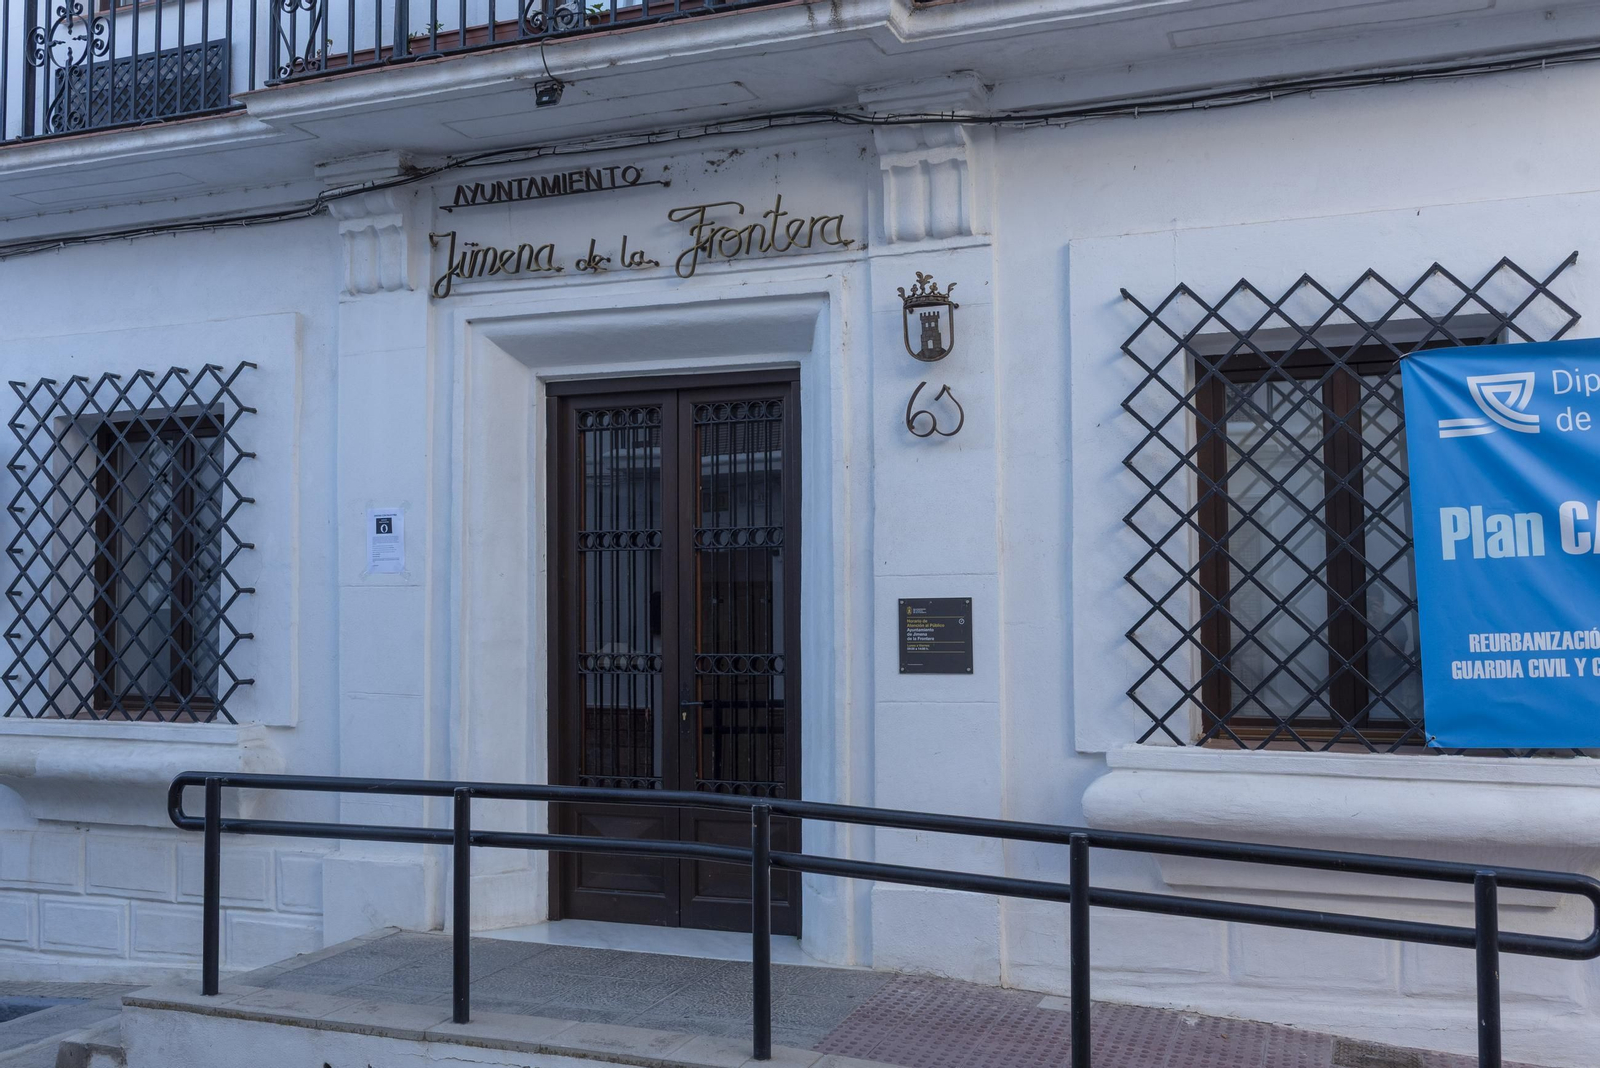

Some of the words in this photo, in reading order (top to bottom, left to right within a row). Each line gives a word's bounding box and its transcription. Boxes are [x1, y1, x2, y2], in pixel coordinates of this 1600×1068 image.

[453, 165, 641, 204] AYUNTAMIENTO
[428, 230, 564, 299] Jimena
[575, 238, 611, 273] de
[620, 234, 660, 268] la
[667, 194, 856, 279] Frontera
[1552, 368, 1600, 397] Dip
[1556, 406, 1592, 432] de
[1439, 505, 1545, 561] Plan
[1559, 500, 1600, 555] C
[1468, 627, 1600, 653] REURBANIZACIÓ
[1451, 659, 1524, 680] GUARDIA
[1528, 658, 1570, 678] CIVIL
[1574, 657, 1587, 677] Y
